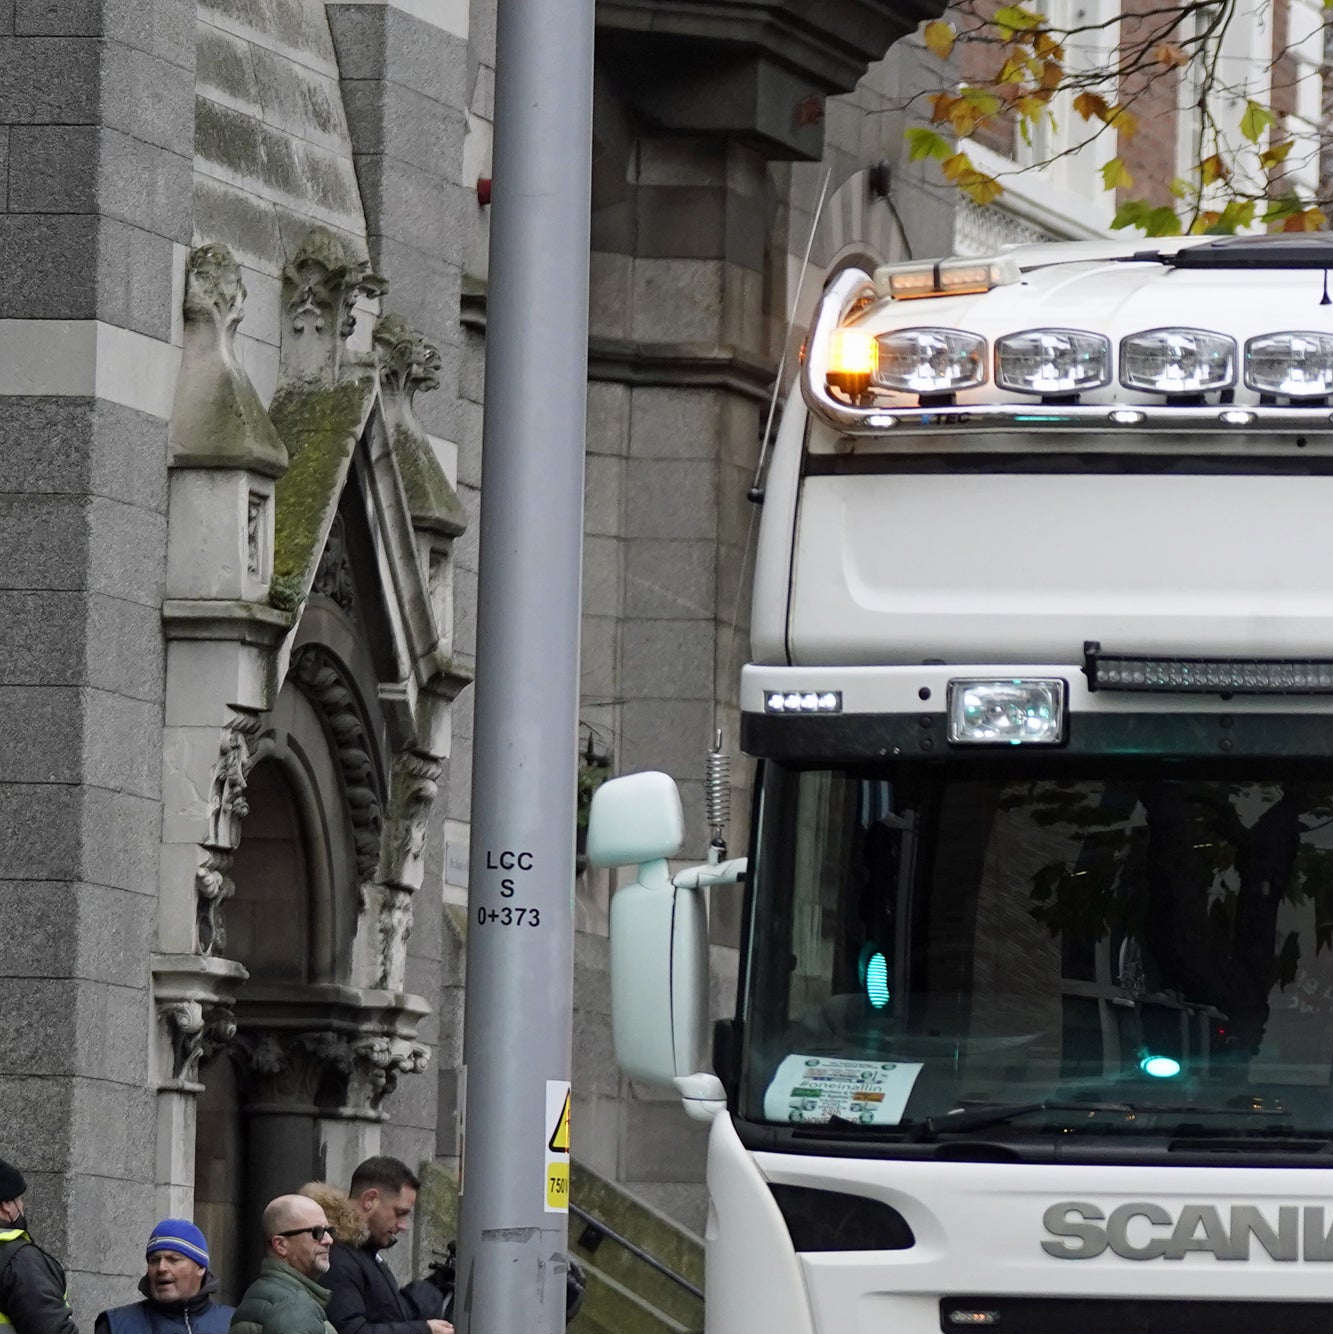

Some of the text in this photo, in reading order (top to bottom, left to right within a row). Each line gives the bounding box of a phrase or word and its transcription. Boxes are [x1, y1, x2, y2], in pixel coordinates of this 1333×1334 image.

[487, 850, 534, 871] LCC
[500, 878, 515, 898] S
[478, 906, 541, 928] 0+373
